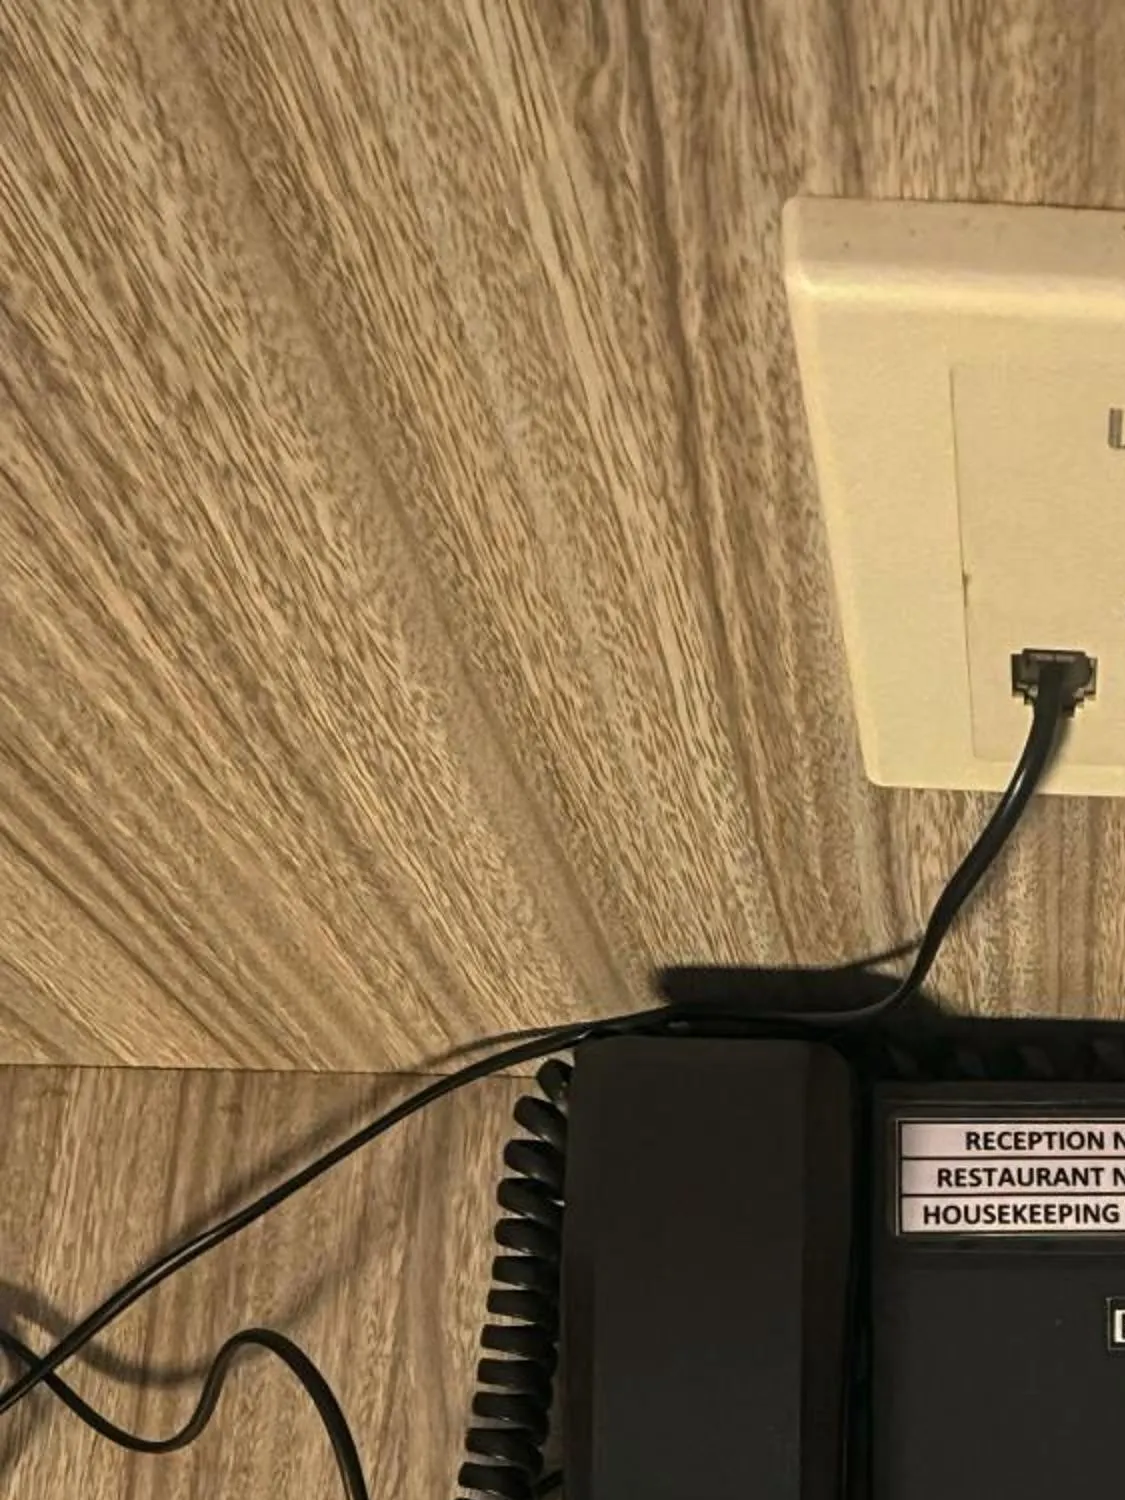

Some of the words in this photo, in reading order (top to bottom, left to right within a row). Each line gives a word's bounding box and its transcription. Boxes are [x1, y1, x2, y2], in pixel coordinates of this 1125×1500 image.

[965, 1130, 1105, 1151] RECEPTION
[936, 1167, 1105, 1188] RESTAURANT
[922, 1203, 1120, 1225] HOUSEKEEPING
